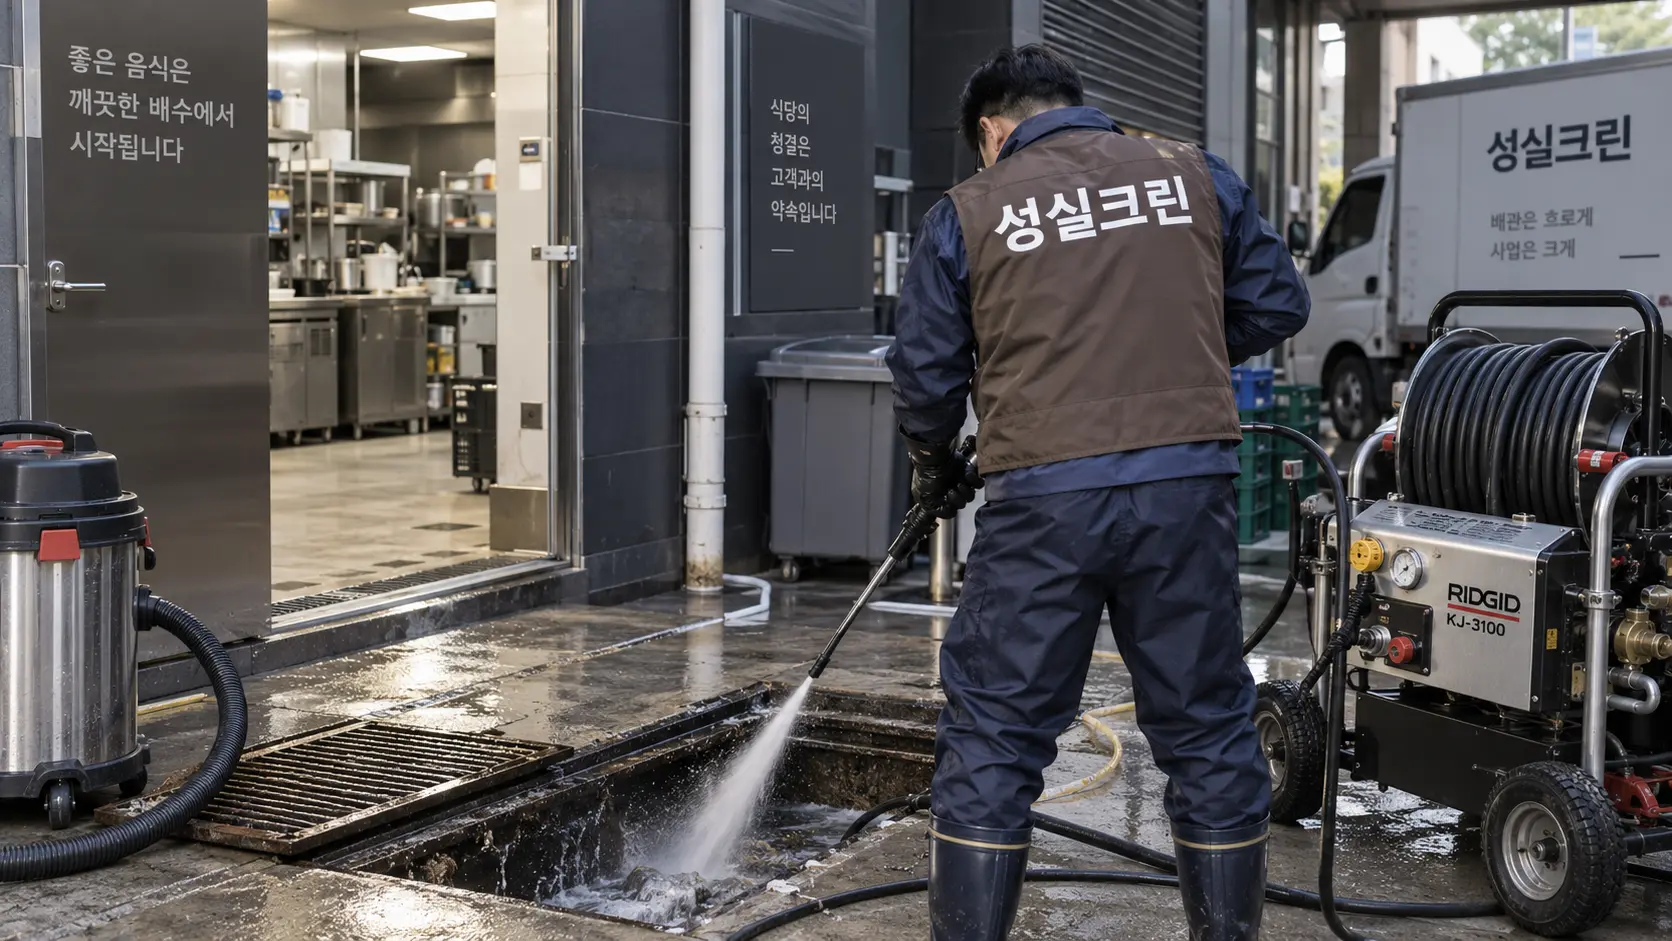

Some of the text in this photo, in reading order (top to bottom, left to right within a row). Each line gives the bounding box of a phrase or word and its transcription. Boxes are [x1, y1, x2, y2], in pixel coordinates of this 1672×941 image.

[68, 45, 192, 84] 좋은 음식은
[69, 88, 234, 129] 깨끗한 배수에서
[770, 99, 810, 125] 식당의
[70, 130, 185, 164] 시작됩니다
[770, 131, 811, 158] 청결은
[1487, 114, 1631, 173] 성실크린
[770, 167, 824, 192] 고객과의
[771, 200, 837, 225] 약속입니다
[994, 175, 1193, 252] 성실크린
[1490, 206, 1594, 232] 배관은 흐로게
[1490, 238, 1576, 261] 사업은 크게
[1448, 582, 1521, 614] RIDGID
[1446, 613, 1506, 637] KJ-3100
